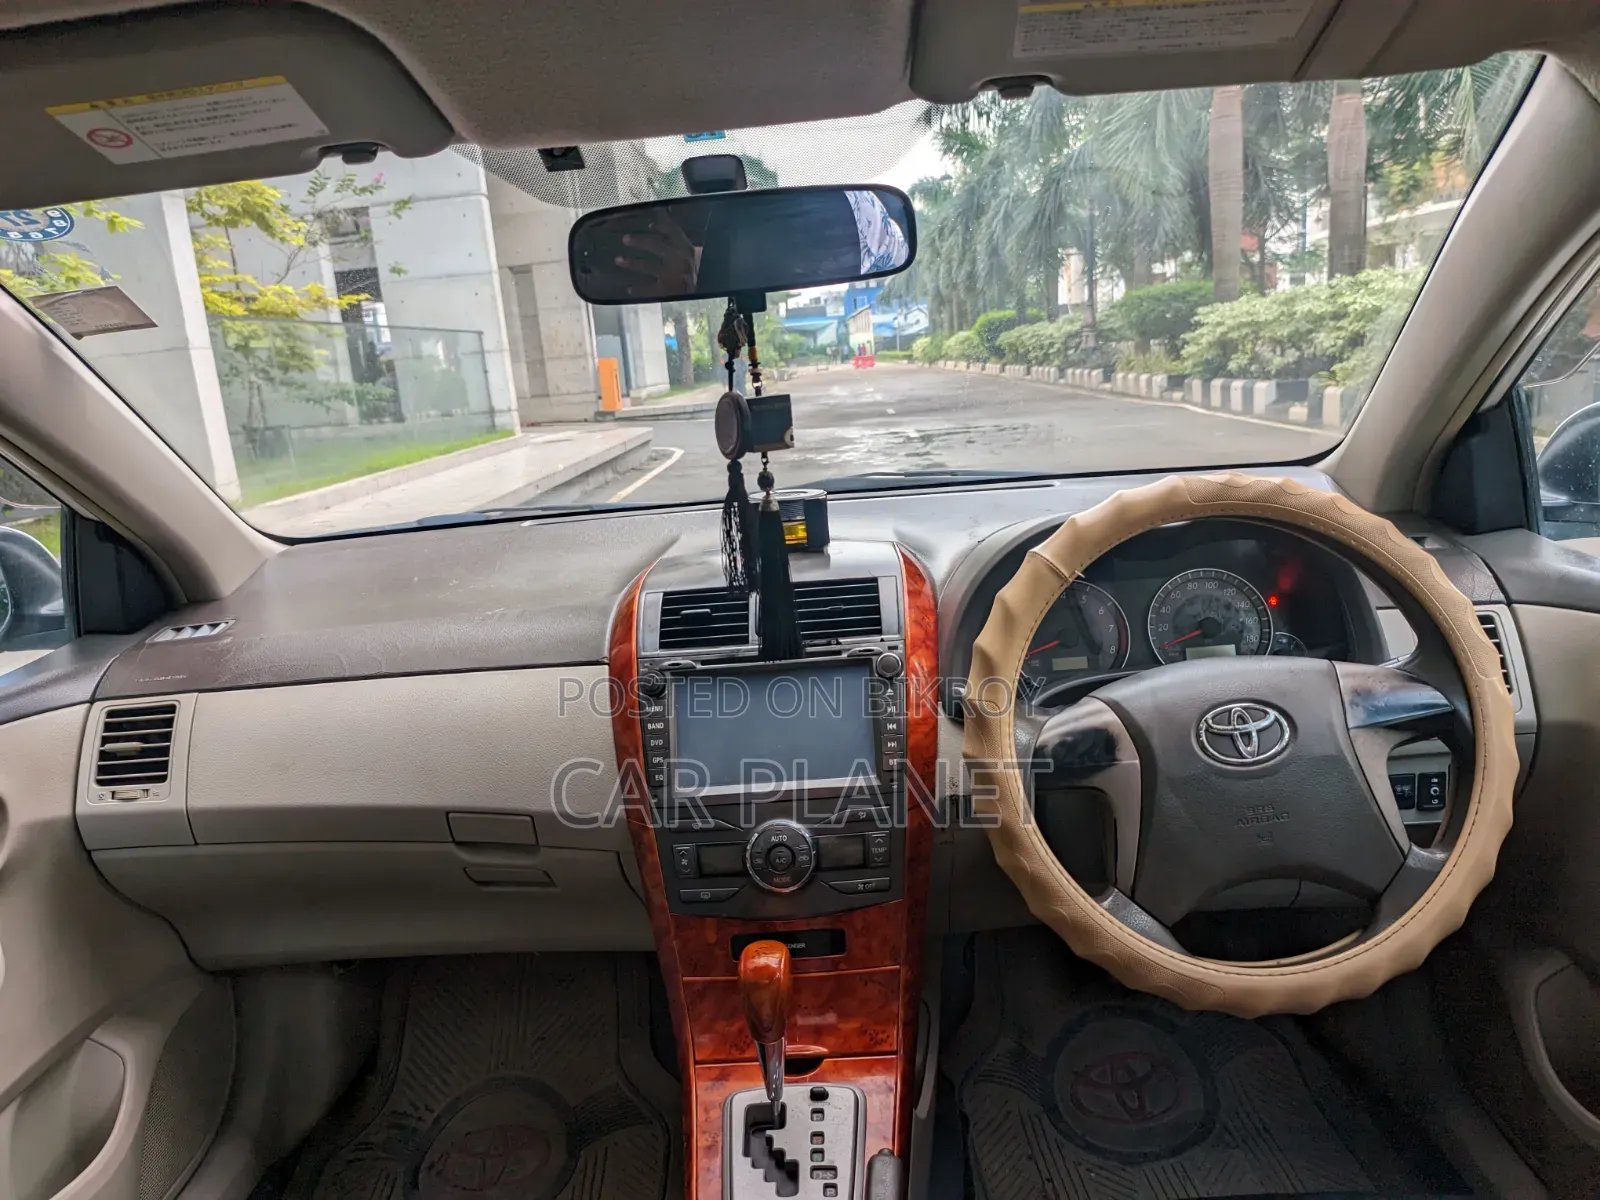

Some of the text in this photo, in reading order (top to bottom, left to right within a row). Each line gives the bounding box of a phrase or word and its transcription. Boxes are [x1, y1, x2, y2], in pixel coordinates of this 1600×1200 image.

[1186, 582, 1198, 590] 80
[1205, 581, 1218, 589] 100
[1170, 591, 1181, 599] 60
[1223, 588, 1236, 596] 120
[1081, 595, 1087, 604] 5
[1098, 607, 1104, 615] 6
[1160, 605, 1171, 613] 40
[1245, 617, 1259, 625] 160
[1108, 624, 1114, 633] 7
[1109, 645, 1116, 654] 8
[1236, 812, 1290, 828] AIRBAG
[865, 882, 876, 890] OFF
